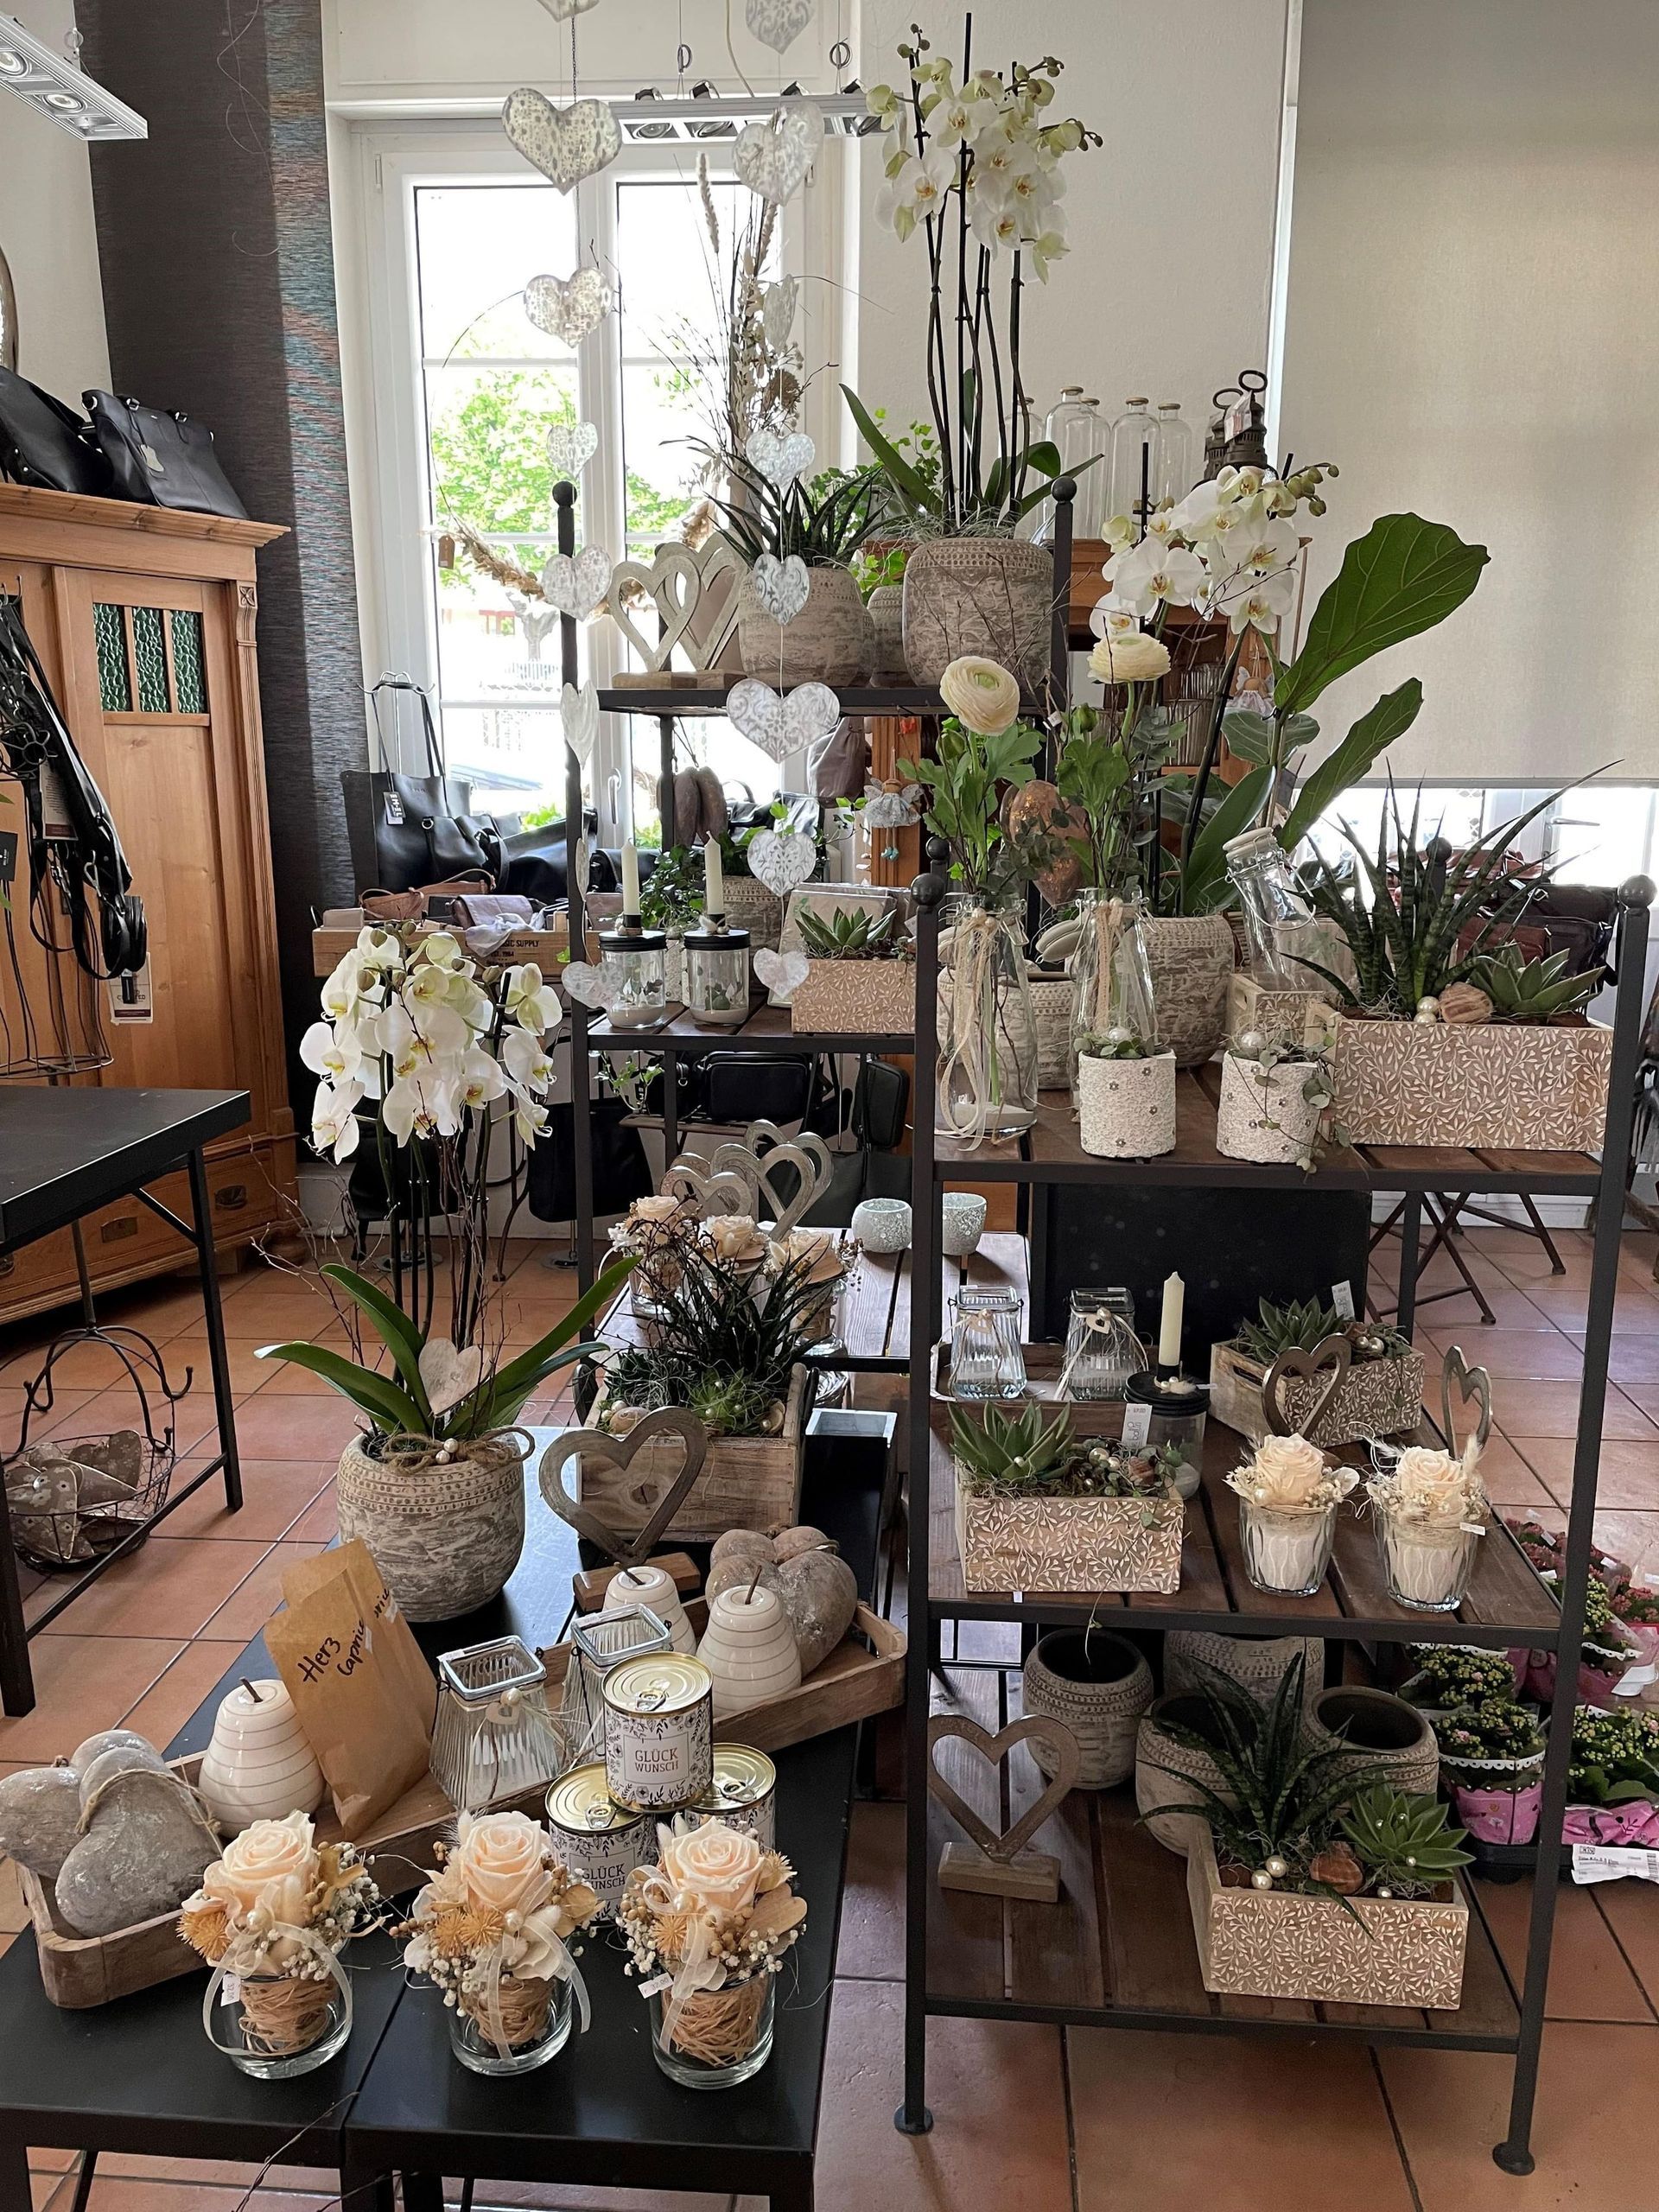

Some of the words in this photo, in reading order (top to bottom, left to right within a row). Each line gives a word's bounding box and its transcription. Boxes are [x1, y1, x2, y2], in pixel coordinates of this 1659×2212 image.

[297, 1637, 340, 1683] Herz
[635, 1747, 678, 1763] GLÜCK
[635, 1760, 678, 1772] WUNSCH
[582, 1862, 625, 1879] GLÜCK
[585, 1876, 626, 1890] UNSCH
